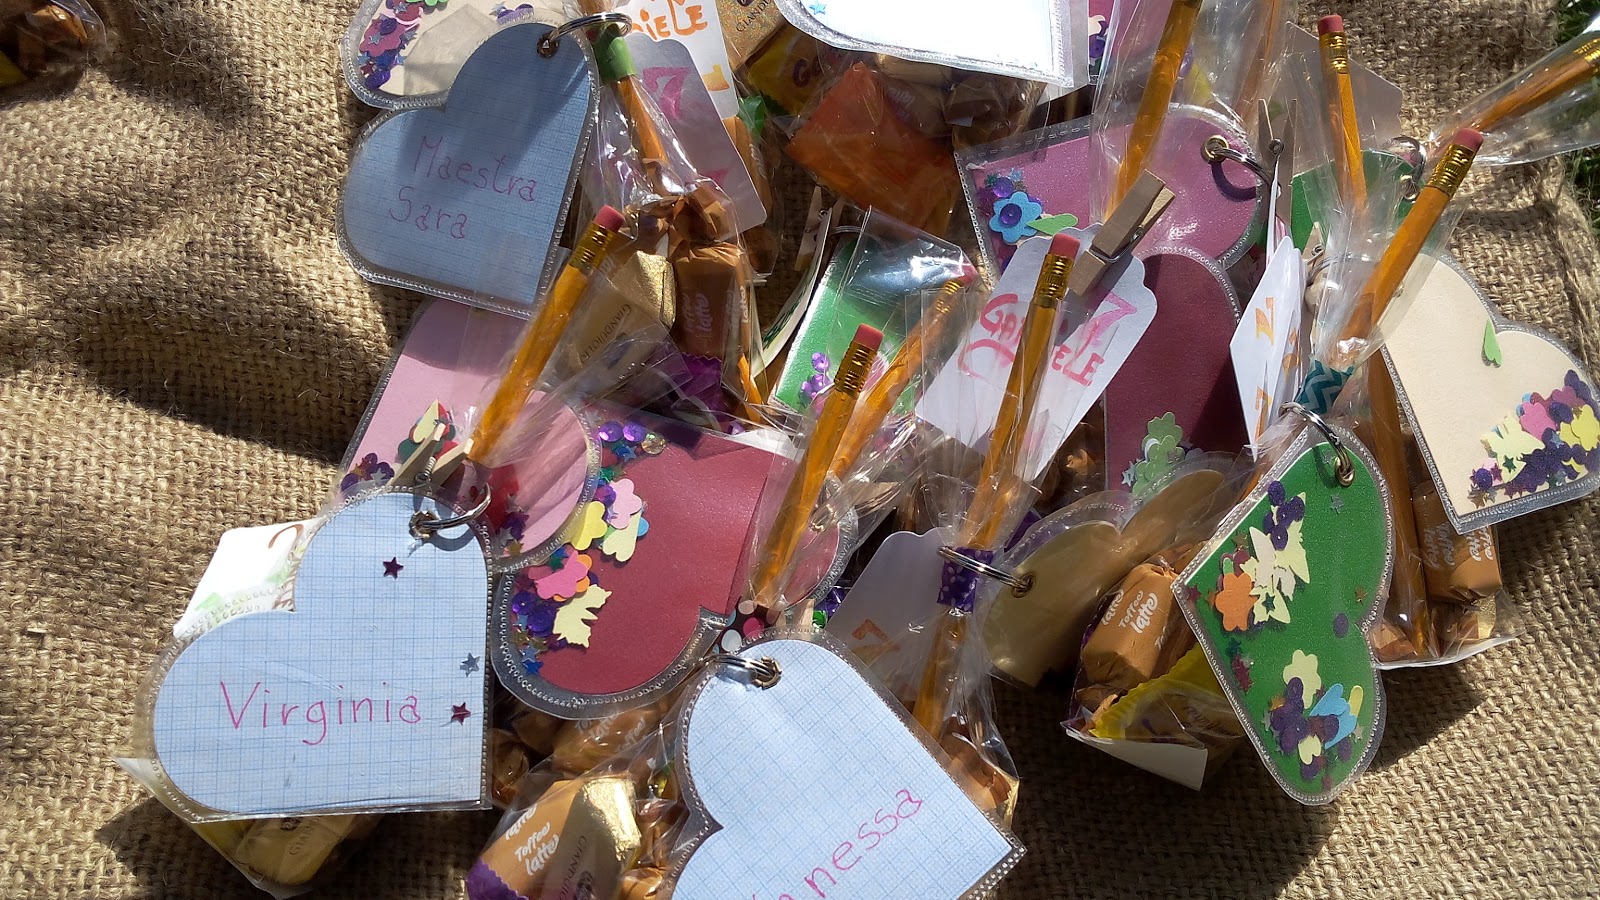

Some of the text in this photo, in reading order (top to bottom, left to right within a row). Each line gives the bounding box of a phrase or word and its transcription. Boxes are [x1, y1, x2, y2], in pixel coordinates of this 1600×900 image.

[413, 135, 537, 202] Maestra
[389, 186, 468, 239] Sara
[1465, 531, 1482, 562] tte
[1478, 525, 1494, 561] ffee
[1118, 590, 1144, 628] Toffee
[1129, 592, 1158, 634] latte
[220, 681, 421, 745] Virginia
[515, 821, 551, 862] Toffee
[525, 834, 560, 876] latte
